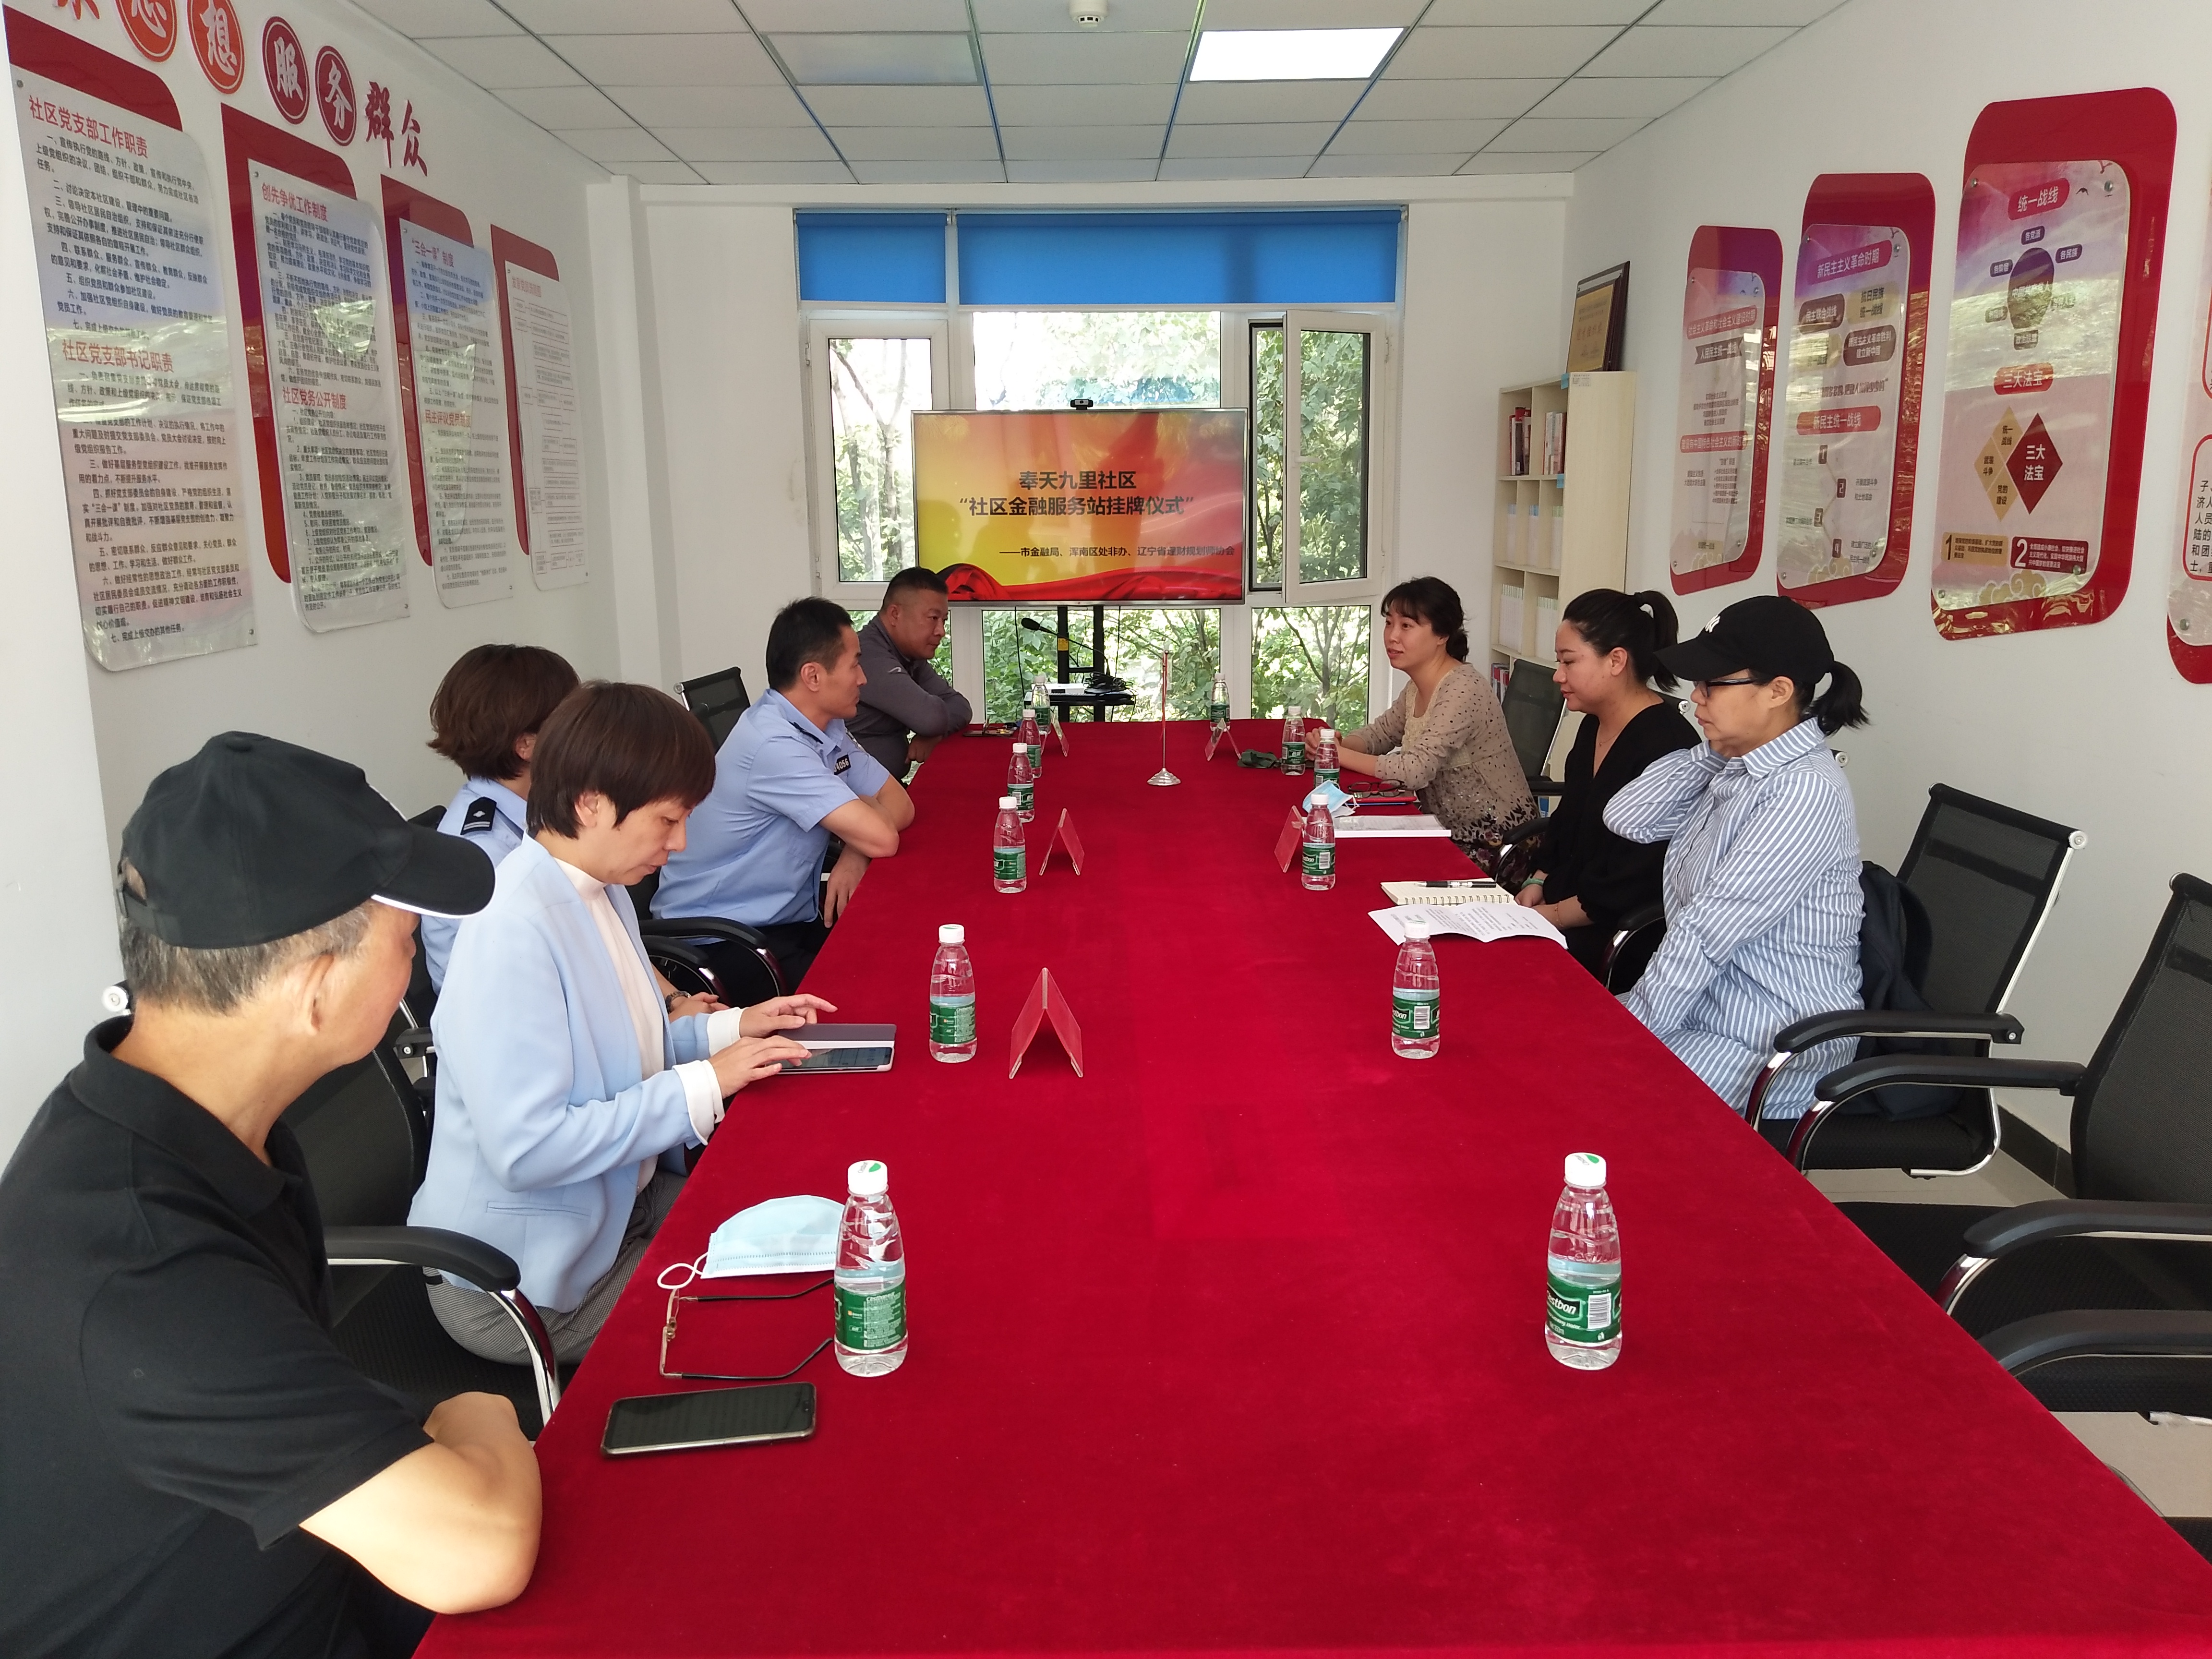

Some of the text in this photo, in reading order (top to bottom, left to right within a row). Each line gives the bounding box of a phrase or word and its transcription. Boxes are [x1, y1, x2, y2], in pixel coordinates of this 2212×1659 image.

[29, 95, 148, 159] 社区党支部工作职责
[37, 158, 55, 173] 任务。
[262, 182, 328, 222] 创先争优工作制度
[2017, 186, 2059, 212] 统一战线
[2025, 229, 2041, 241] 各党派
[2060, 248, 2078, 260] 各民族
[1817, 248, 1879, 278] 新民主主义革命时期
[1994, 263, 2009, 274] 各阶层
[66, 272, 156, 300] 五、组织党员和群众参加社区建设。
[1861, 287, 1885, 303] 抗日民族
[57, 301, 87, 315] 党员工作。
[1806, 305, 1837, 322] 民主联合战线
[1860, 303, 1883, 318] 统一战线
[1688, 309, 1756, 336] 社会主义革命和社会主义建设时期
[1848, 330, 1891, 348] 新民主主义革命胜利
[62, 338, 174, 373] 社区党支部书记职责
[1856, 345, 1881, 359] 建立新中国
[2003, 369, 2044, 388] 三大法宝
[282, 386, 347, 410] 社区党务公开制度
[425, 409, 471, 428] 民主评议党员制度
[1813, 412, 1861, 430] 新民主统一战线
[2002, 425, 2013, 434] 统一
[2001, 436, 2012, 445] 战线
[74, 443, 126, 455] 级党组织报告工作。
[2025, 444, 2046, 460] 三大
[1983, 456, 1994, 465] 武装
[1983, 467, 1994, 476] 斗争
[2024, 464, 2044, 481] 法宝
[1019, 470, 1137, 490] 奉天九里社区
[1839, 482, 1844, 494] 2
[1997, 484, 2008, 494] 党的
[959, 496, 1194, 517] “社区金融服务站挂牌仪式”
[1996, 495, 2007, 505] 建设
[1816, 512, 1821, 523] 3
[2195, 512, 2212, 525] 人员
[85, 532, 113, 542] 和战斗力。
[2193, 528, 2211, 541] 陆的
[1834, 543, 1839, 554] 4
[1945, 534, 1952, 561] 1
[2014, 538, 2027, 567] 2
[2191, 544, 2212, 557] 和团
[111, 623, 184, 643] 七、完成上级交办的其他任务。
